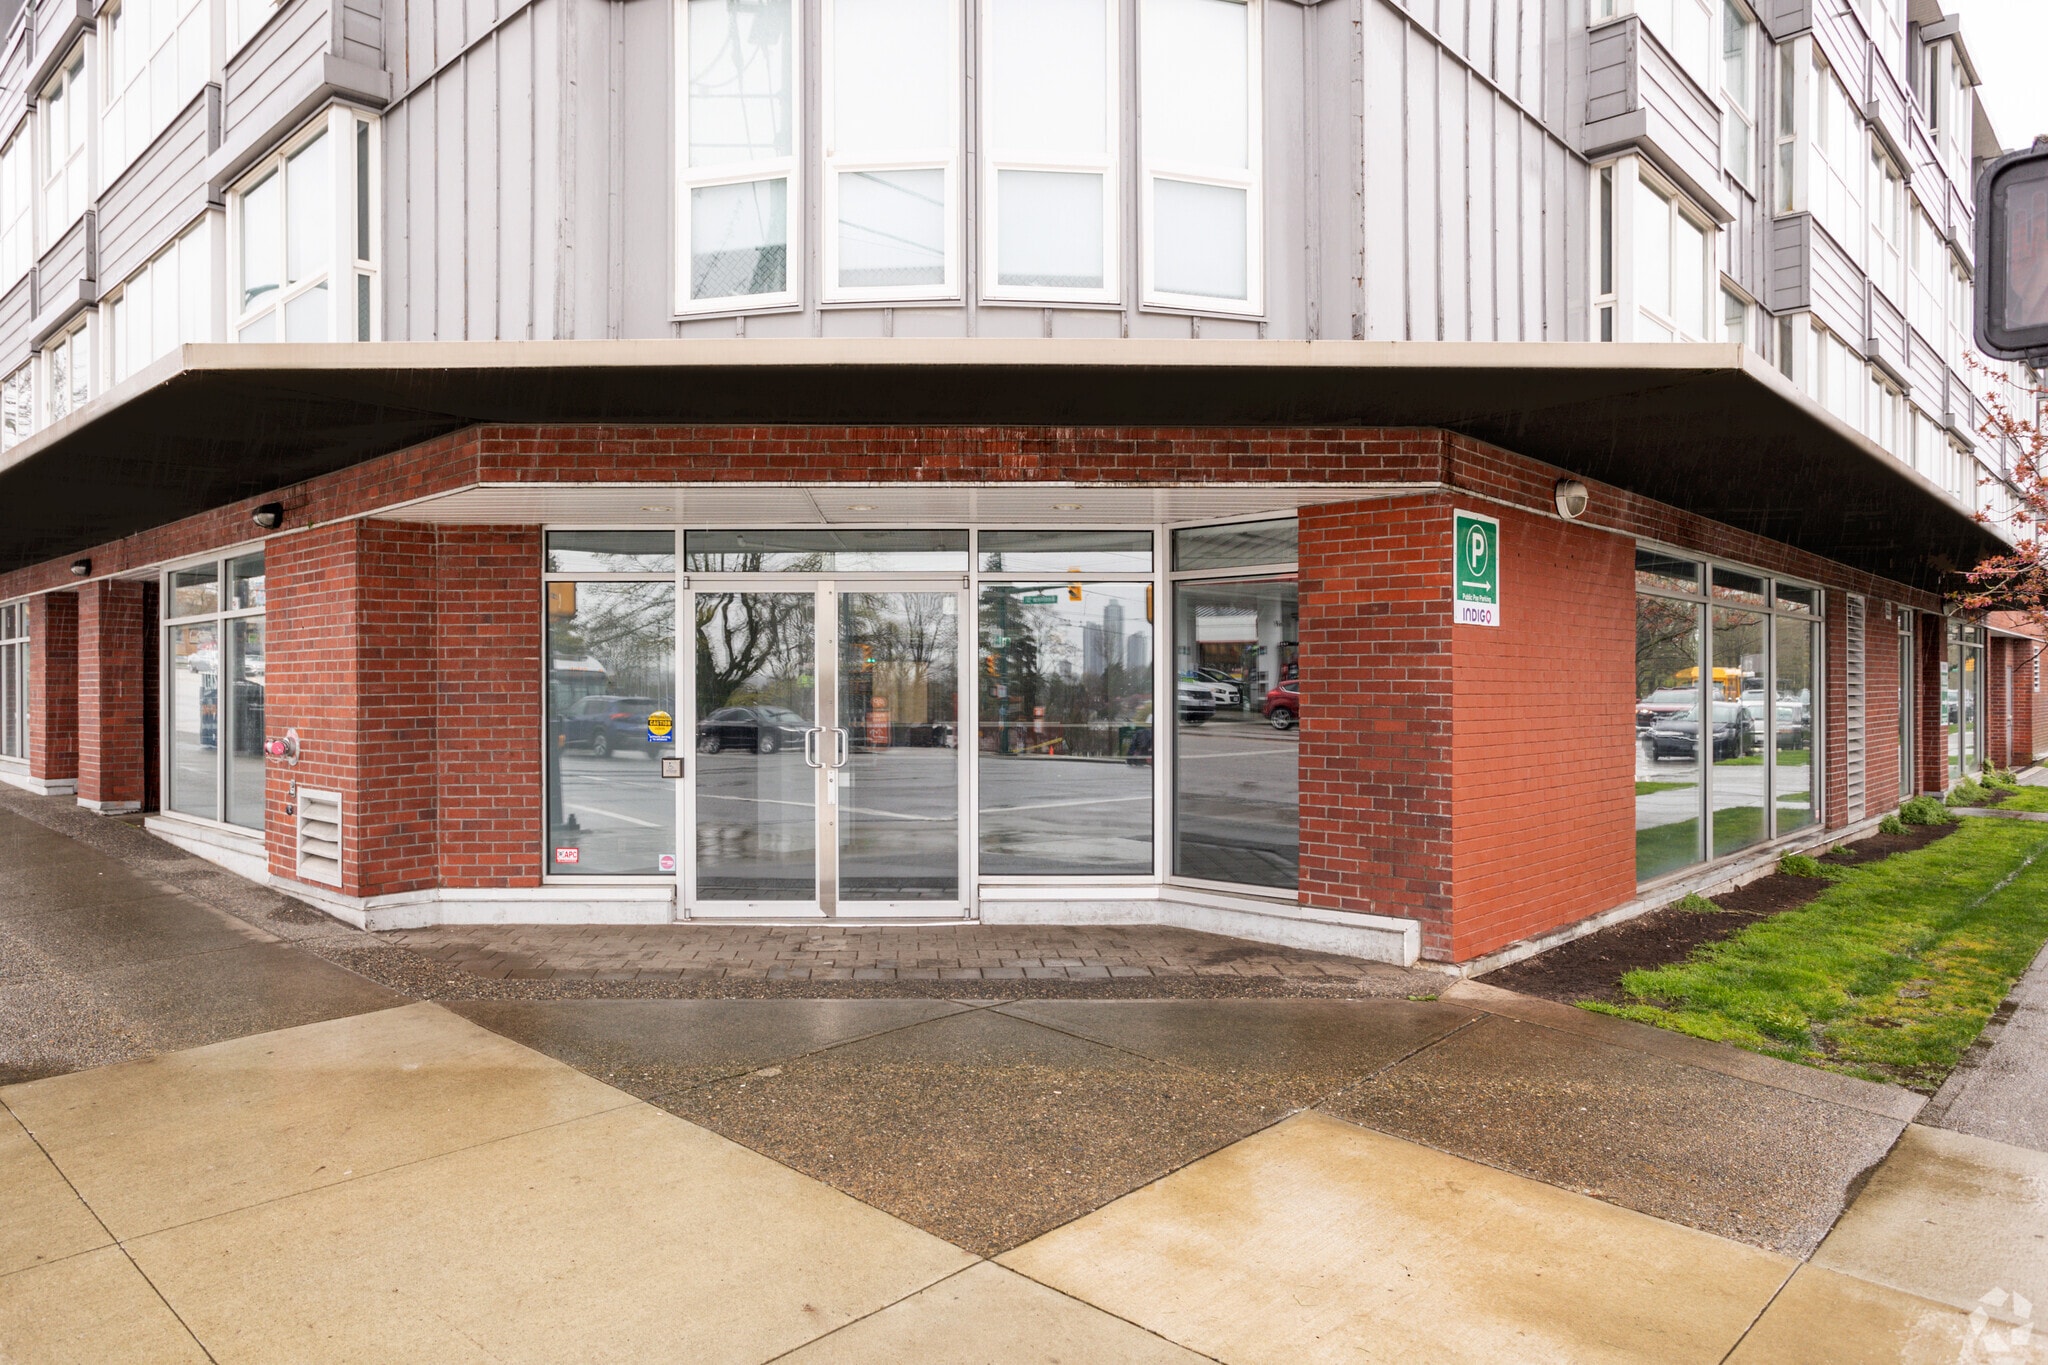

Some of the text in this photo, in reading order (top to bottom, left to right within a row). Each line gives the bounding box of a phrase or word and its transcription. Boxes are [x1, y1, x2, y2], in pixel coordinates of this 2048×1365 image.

[1472, 532, 1484, 567] P
[1462, 593, 1472, 601] Public
[1479, 595, 1491, 604] Parking
[1462, 607, 1491, 624] INDIGO
